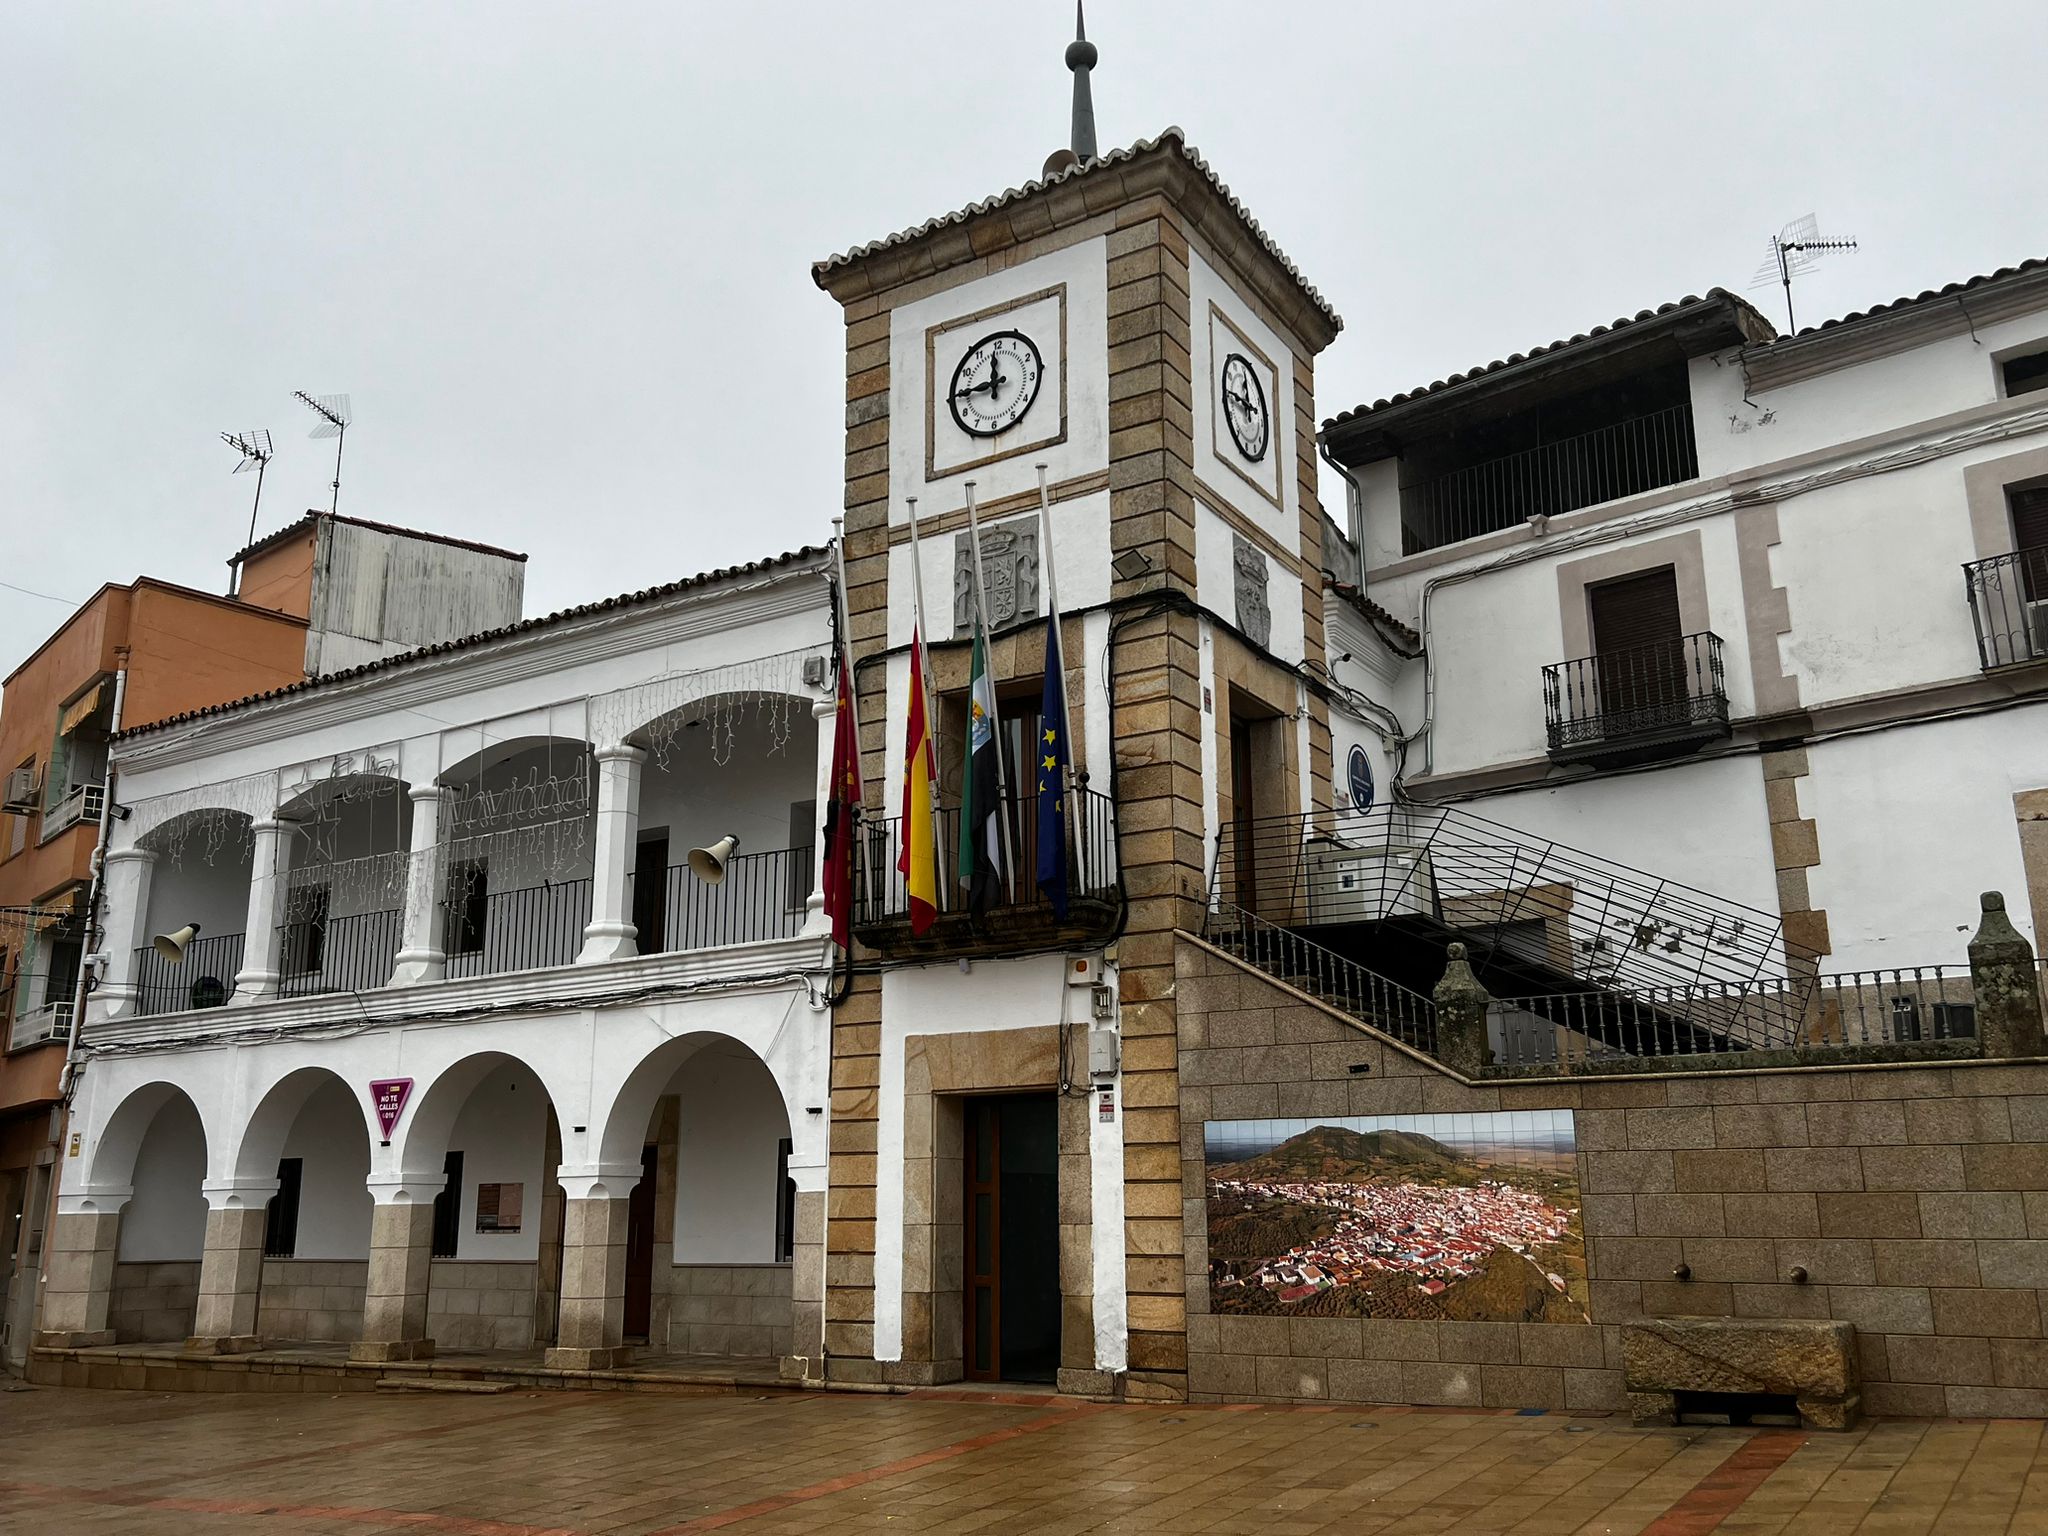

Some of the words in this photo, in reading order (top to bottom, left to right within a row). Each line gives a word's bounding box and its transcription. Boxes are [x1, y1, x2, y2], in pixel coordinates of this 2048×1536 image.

[993, 340, 1003, 350] 12
[1012, 341, 1017, 350] 1
[975, 350, 983, 360] 11
[1025, 353, 1031, 362] 2
[962, 368, 971, 378] 10
[1030, 372, 1035, 381] 3
[1023, 394, 1028, 403] 4
[962, 408, 968, 417] 8
[1010, 411, 1016, 420] 5
[974, 419, 980, 428] 7
[991, 421, 997, 430] 6
[439, 755, 586, 833] Navidad
[380, 1095, 390, 1103] NO
[379, 1103, 398, 1111] CALLES
